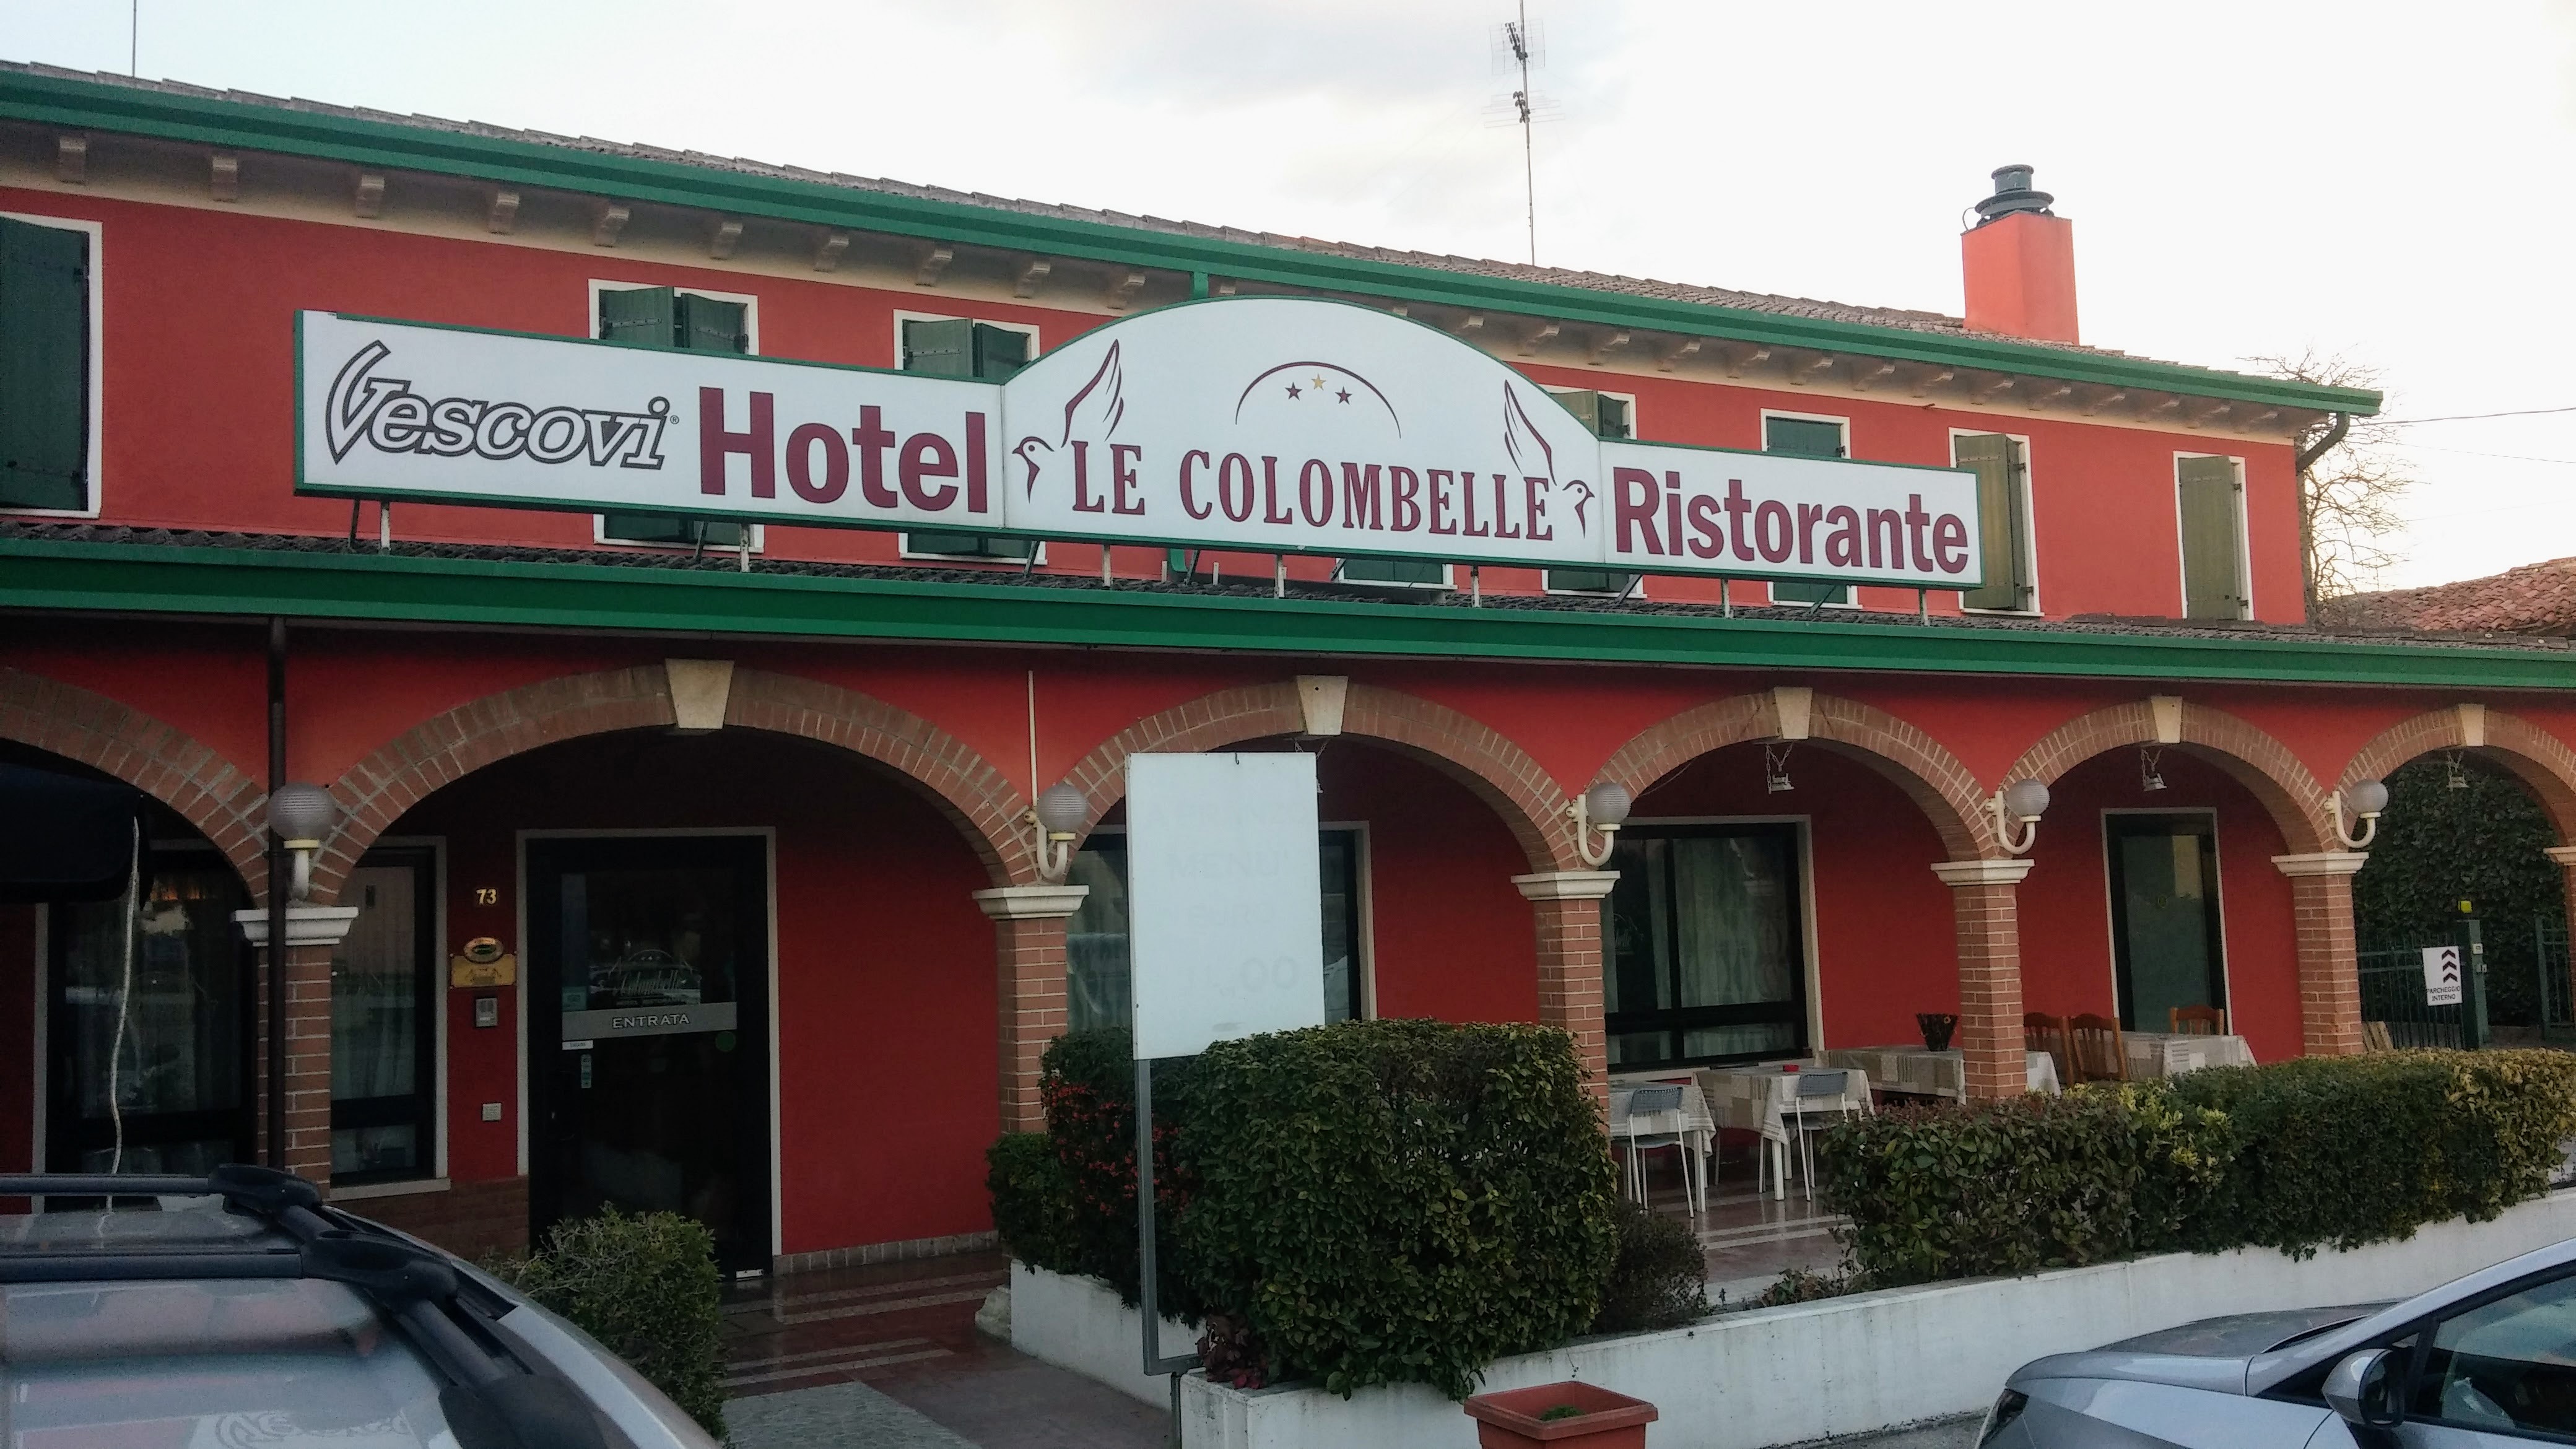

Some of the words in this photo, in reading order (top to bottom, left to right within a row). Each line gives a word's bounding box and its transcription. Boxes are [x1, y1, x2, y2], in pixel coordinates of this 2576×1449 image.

[698, 385, 988, 514] Hotel
[1071, 440, 1146, 516] LE
[1179, 450, 1554, 541] COLOMBELLE
[1612, 466, 1970, 574] Ristorante
[476, 889, 497, 905] 73
[612, 1013, 690, 1029] ENTRATA
[2432, 994, 2456, 1002] INTERNO
